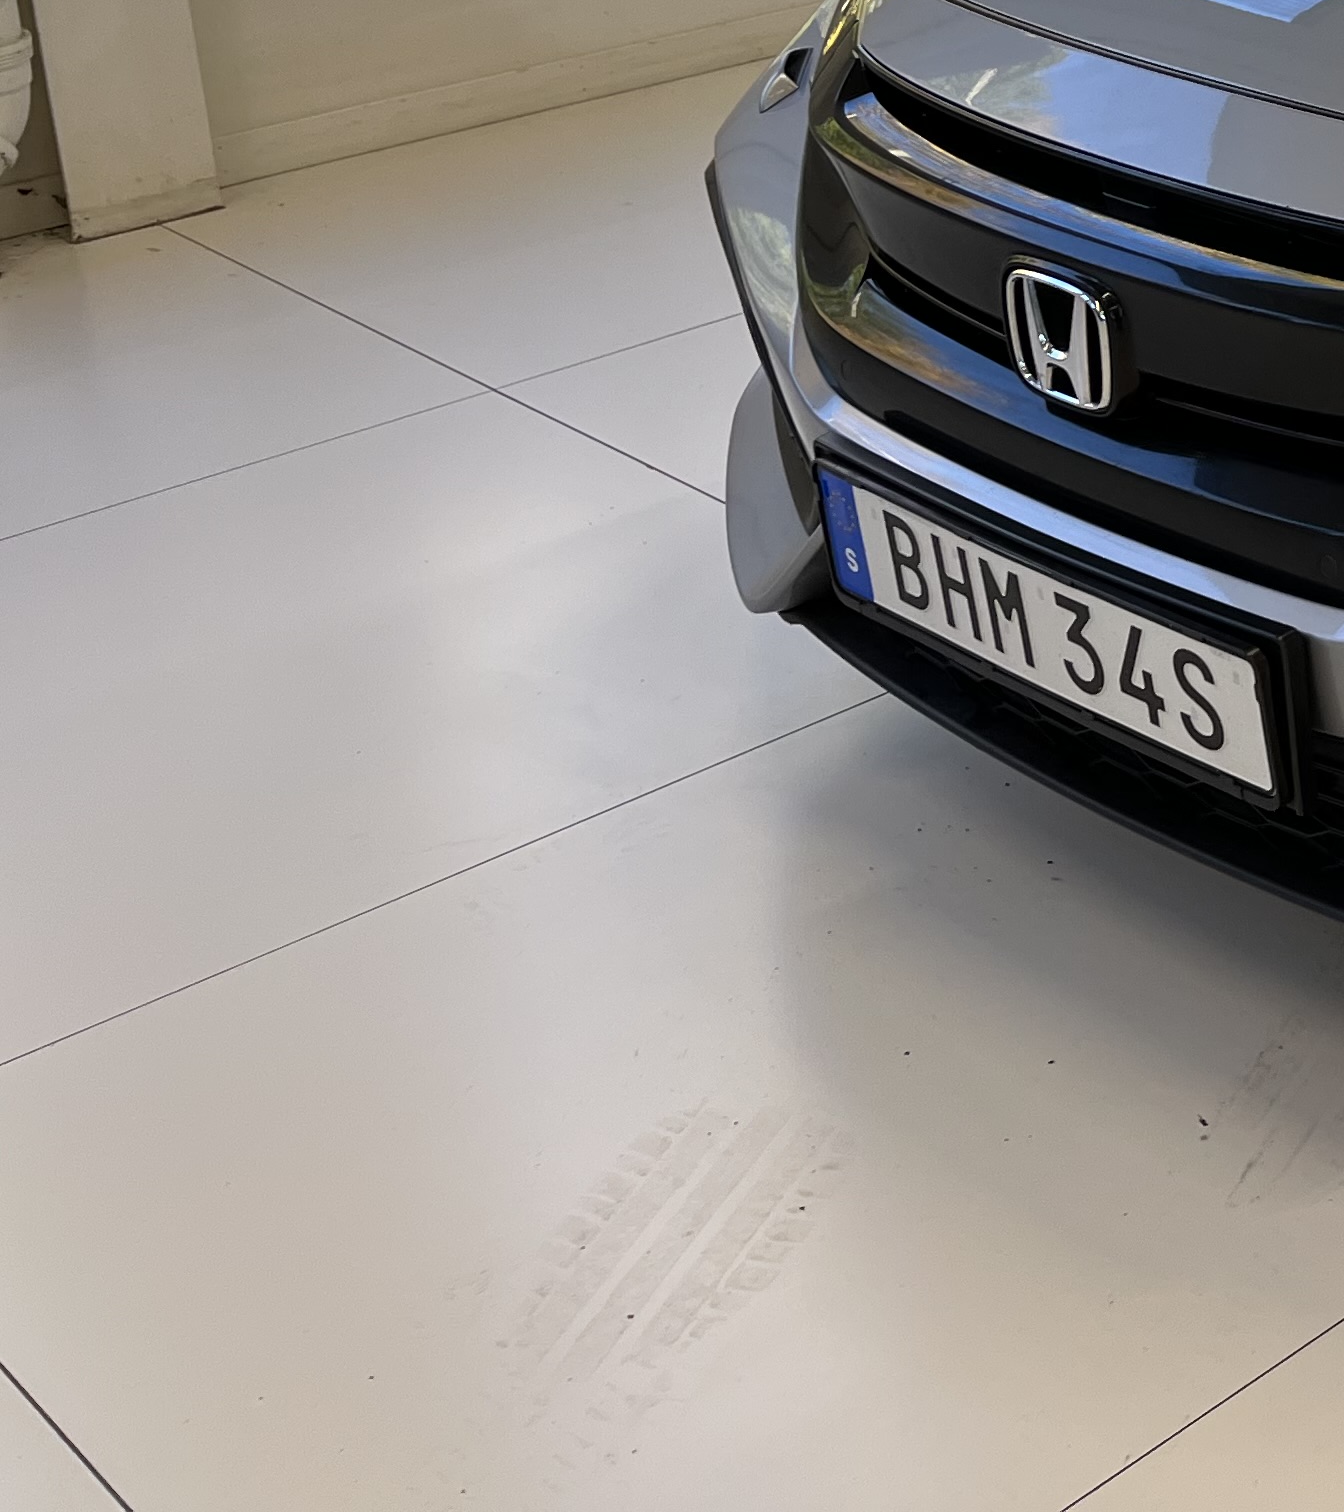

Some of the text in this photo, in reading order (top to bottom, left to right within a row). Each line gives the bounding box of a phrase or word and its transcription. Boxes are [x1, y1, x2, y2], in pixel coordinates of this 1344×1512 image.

[845, 547, 859, 573] S
[883, 509, 1226, 751] BHM 34S
